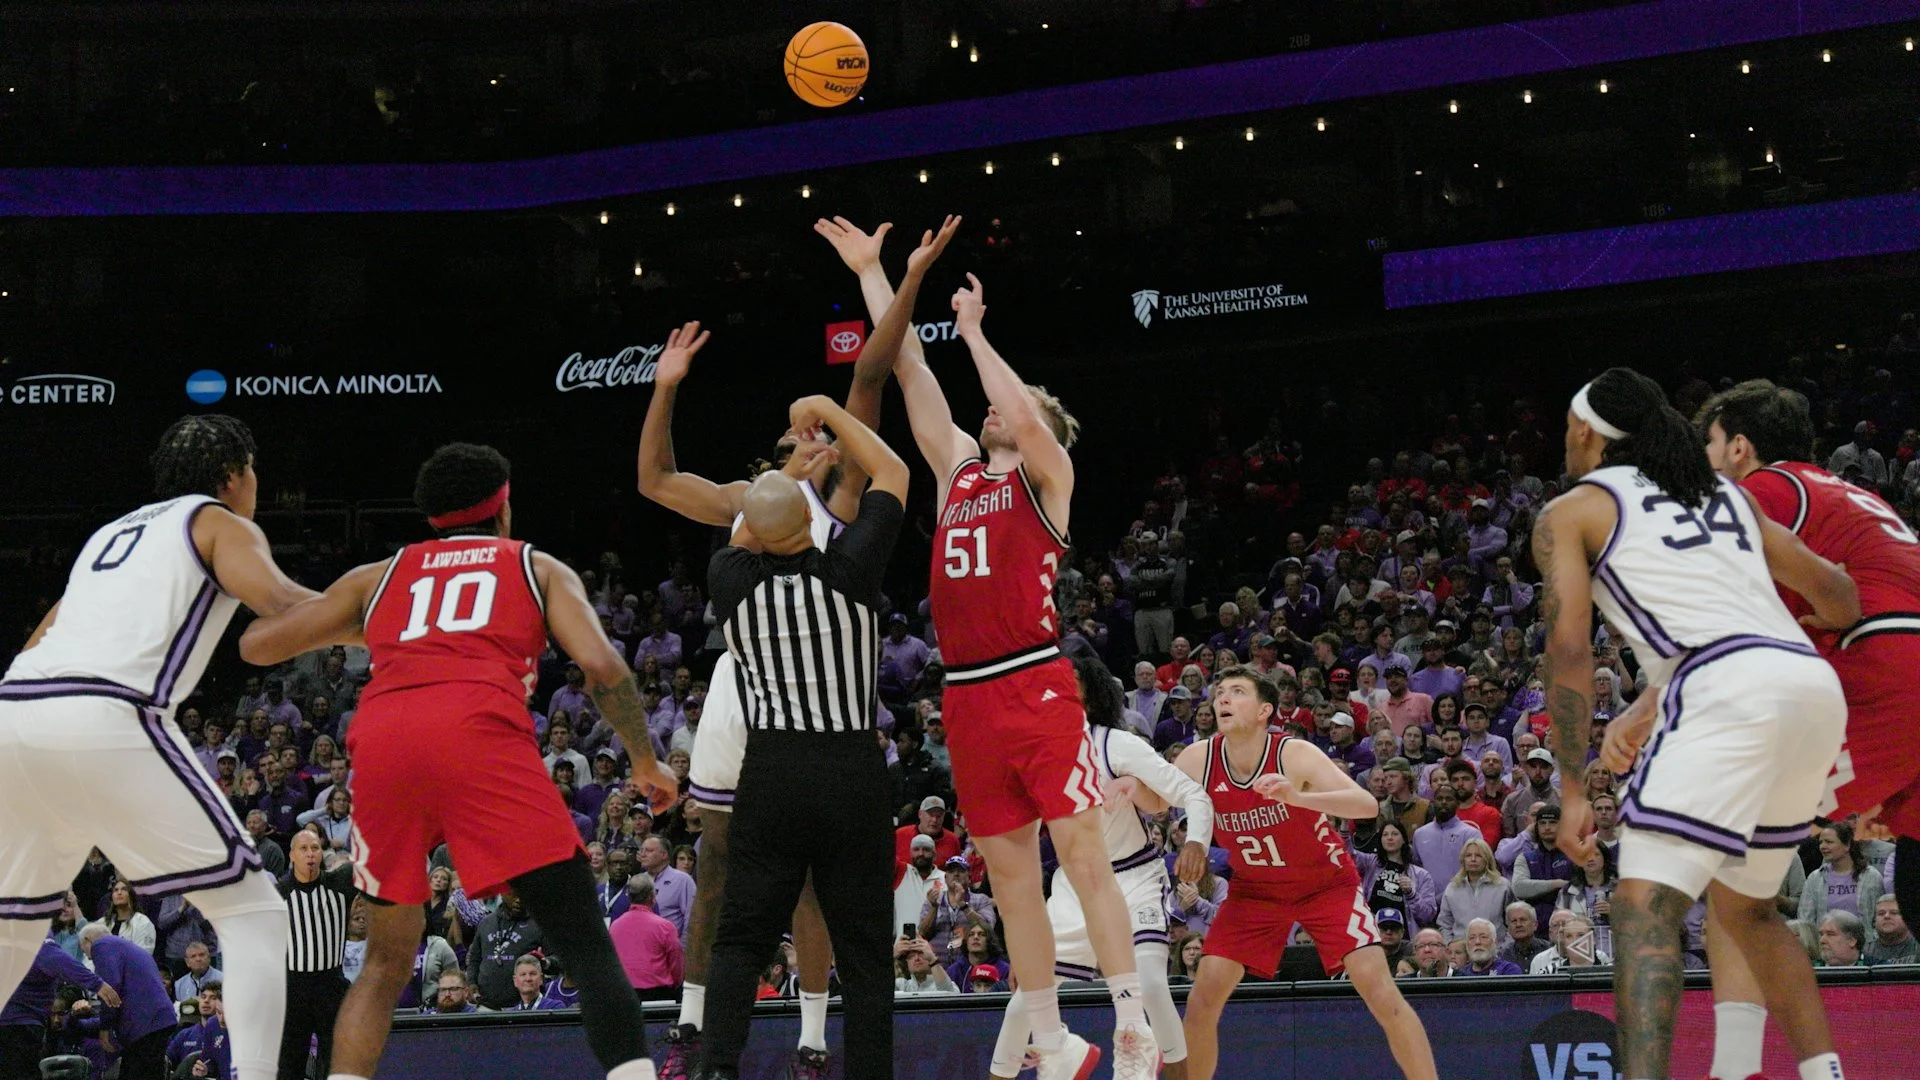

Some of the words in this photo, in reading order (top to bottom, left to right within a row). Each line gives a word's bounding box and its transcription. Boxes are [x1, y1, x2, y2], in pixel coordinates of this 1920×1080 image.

[836, 57, 867, 69] NCAA
[1163, 294, 1189, 309] THE
[1191, 286, 1265, 305] UNIVERSITY
[1266, 284, 1284, 297] OF
[1164, 304, 1211, 320] KANSAS
[1213, 299, 1261, 315] HEALTH
[1263, 294, 1309, 309] SYSTEM
[10, 384, 106, 405] CENTER
[235, 375, 331, 396] KONICA
[335, 373, 443, 395] MINOLTA
[1641, 491, 1754, 553] 34
[91, 523, 147, 573] 0
[421, 546, 498, 570] LAWRENCE
[944, 525, 992, 579] 51
[398, 569, 499, 643] 10
[1215, 801, 1291, 833] NEBRASKA
[1235, 834, 1288, 868] 21
